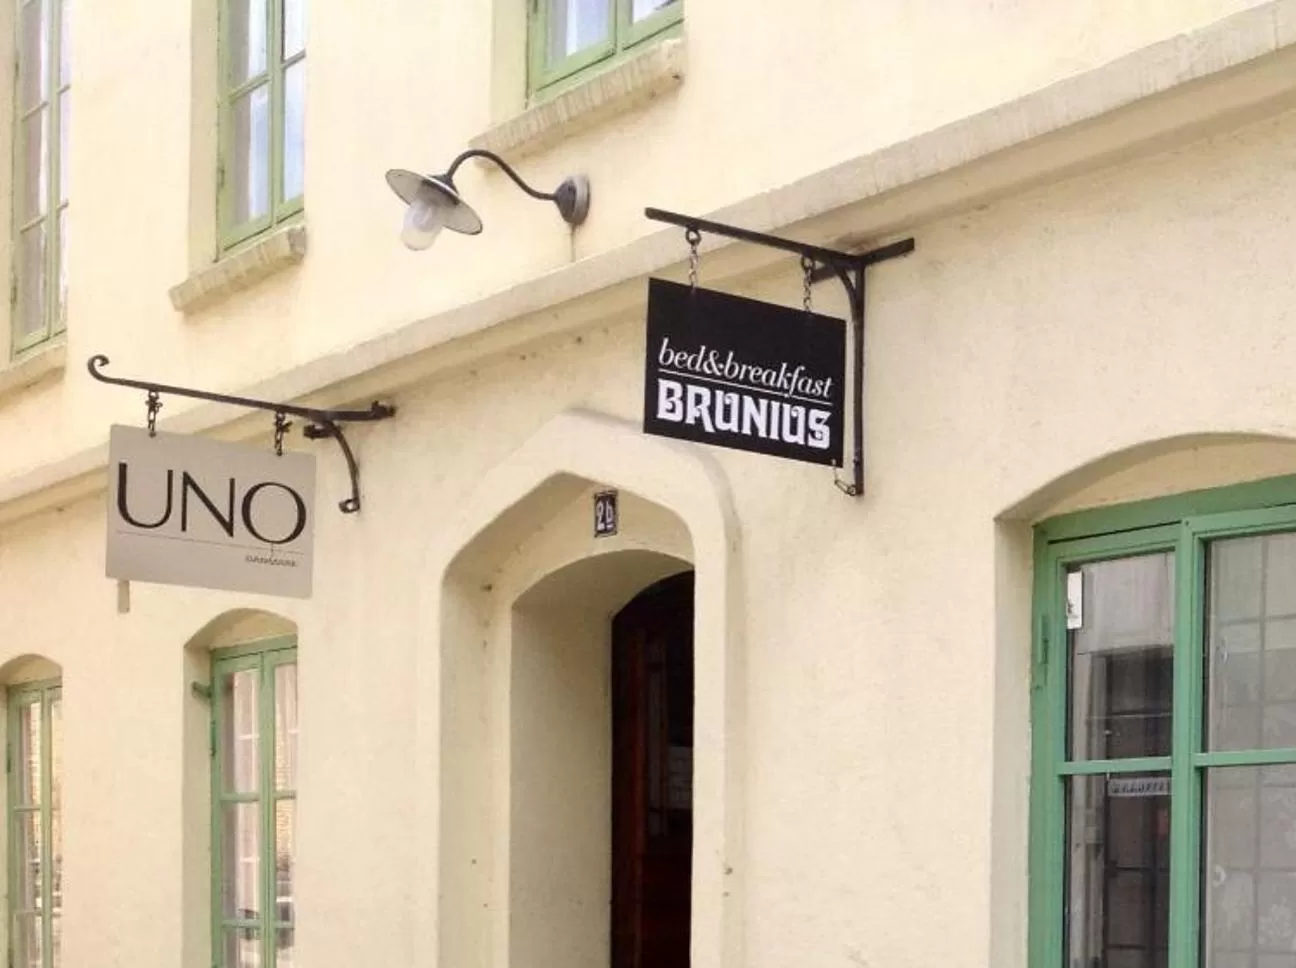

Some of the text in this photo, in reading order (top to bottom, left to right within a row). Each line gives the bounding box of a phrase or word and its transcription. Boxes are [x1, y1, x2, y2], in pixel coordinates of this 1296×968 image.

[658, 337, 834, 399] bed&breakfast
[656, 378, 833, 450] BRUNIUS
[117, 462, 307, 545] UNO
